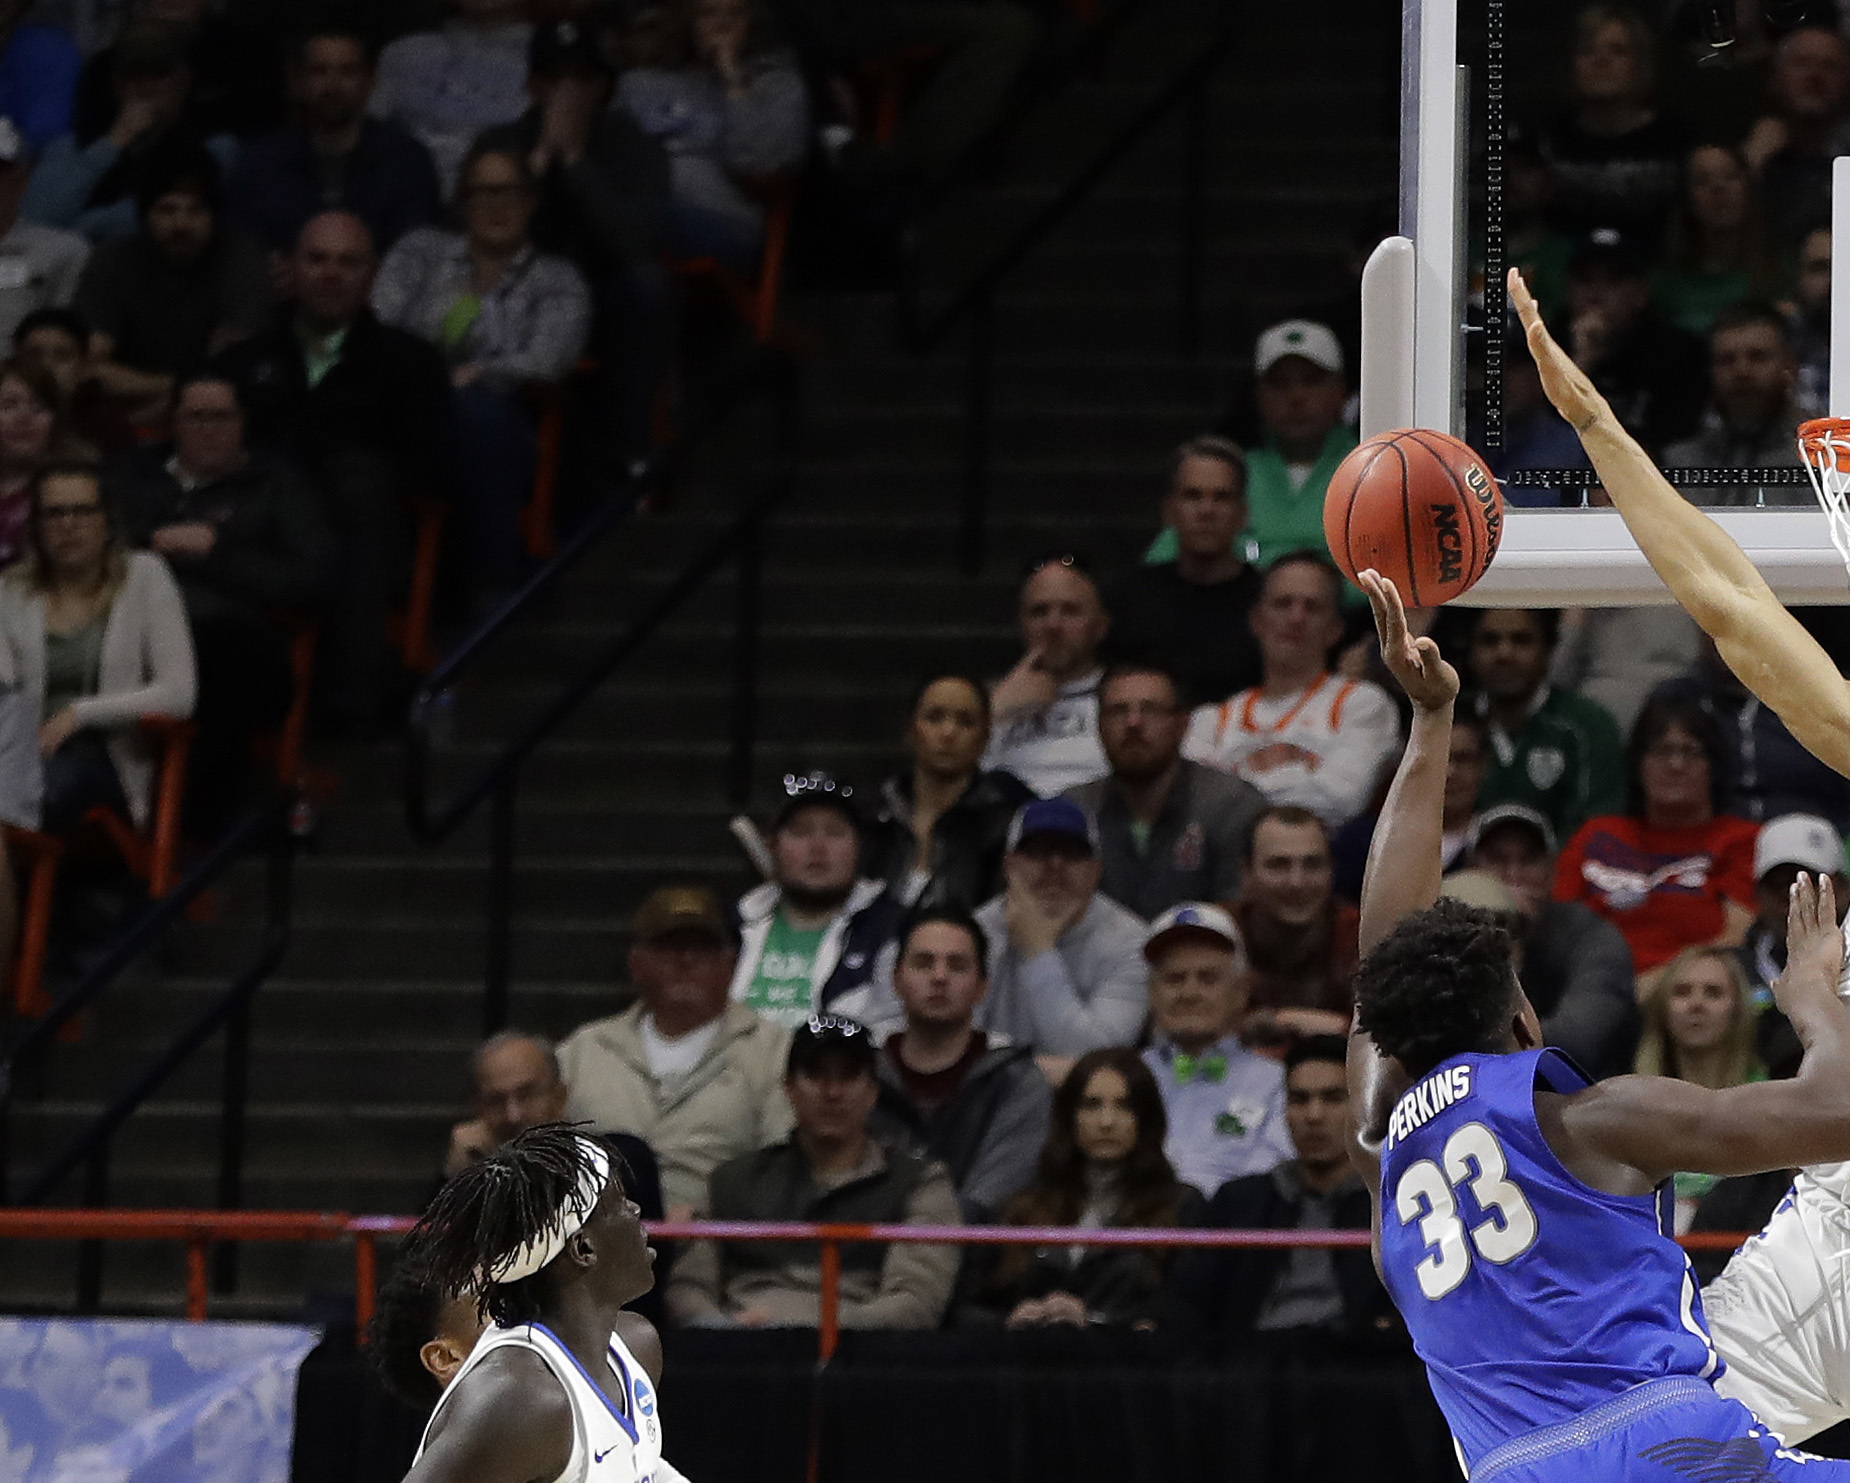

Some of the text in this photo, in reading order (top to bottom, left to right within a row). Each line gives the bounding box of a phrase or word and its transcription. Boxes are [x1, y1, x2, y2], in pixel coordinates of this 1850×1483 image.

[1430, 503, 1463, 584] NCAA
[1388, 1064, 1471, 1151] PERKINS
[1396, 1121, 1539, 1302] 33
